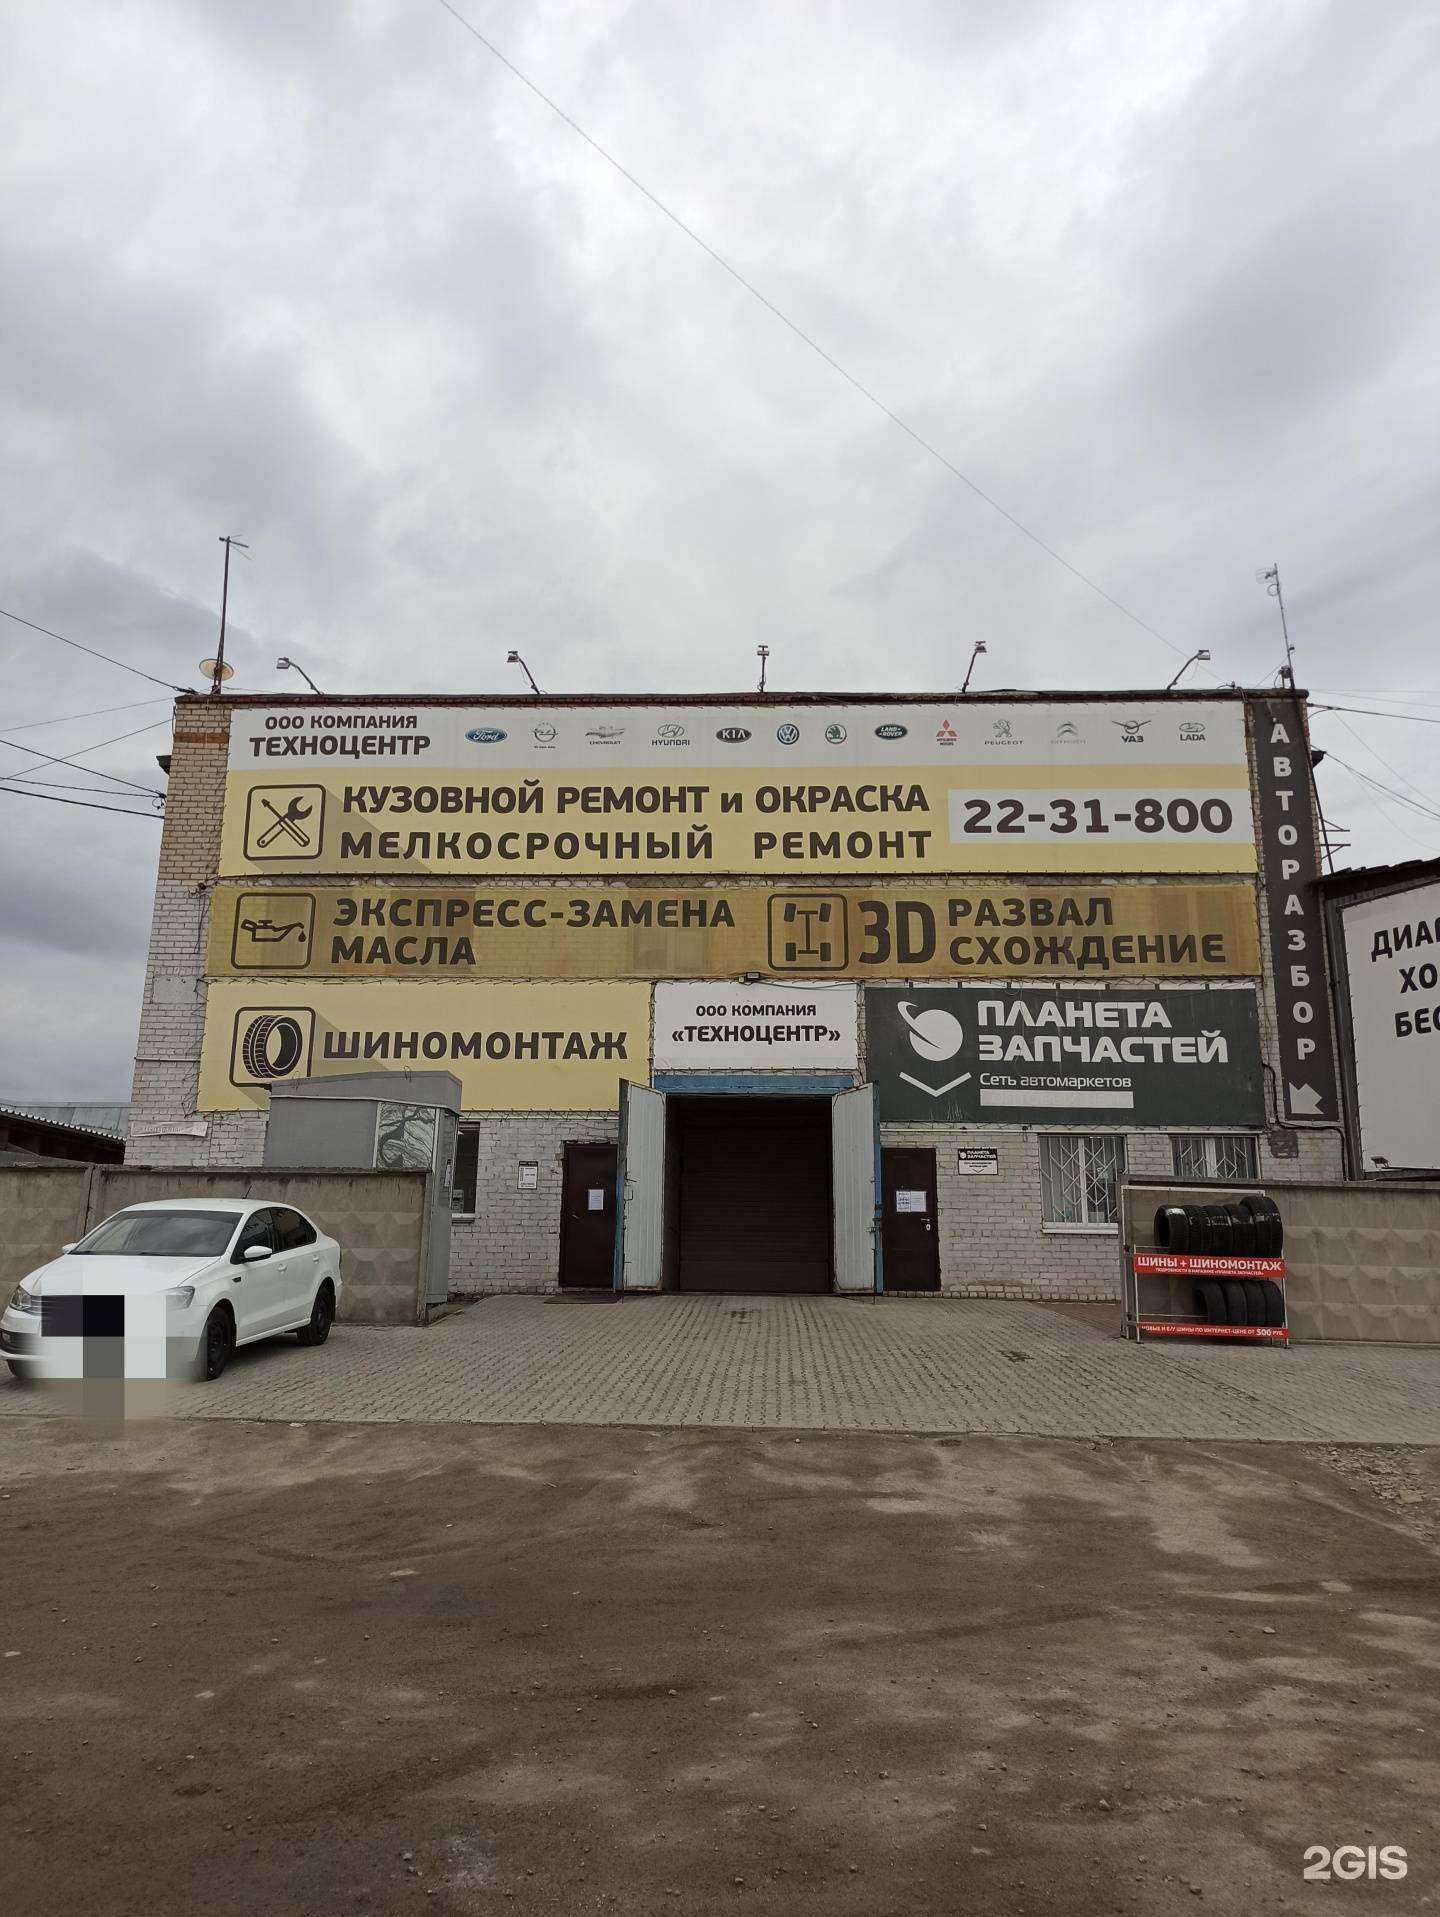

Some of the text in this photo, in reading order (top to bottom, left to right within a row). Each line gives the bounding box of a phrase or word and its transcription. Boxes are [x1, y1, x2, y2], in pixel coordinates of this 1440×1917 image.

[264, 715, 418, 730] ООО КОМПАНИЯ
[473, 728, 501, 742] Ford
[721, 730, 746, 740] KIA
[249, 735, 431, 759] ТЕХНОЦЕНТР
[1121, 735, 1144, 743] УАЗ
[1180, 734, 1206, 742] LADA
[343, 779, 930, 814] КУЗОВНОЙ РЕМОНТ и ОКРАСКА
[963, 799, 1233, 834] 22-31-800
[340, 824, 932, 860] МЕЛКОСРОЧНЫЙ РЕМОНТ
[1269, 722, 1316, 1061] АВТОРАЗБОР
[332, 898, 736, 929] ЭКСПРЕСС-ЗАМЕНА
[948, 898, 1114, 927] РАЗВАЛ
[858, 900, 937, 965] 3D
[330, 936, 476, 966] МАСЛА
[948, 934, 1226, 970] СХОЖДЕНИЕ
[696, 1004, 817, 1018] ООО КОМПАНИЯ
[978, 1001, 1172, 1028] ПЛАНЕТА
[323, 1031, 628, 1060] ШИНОМОНТАЖ
[671, 1024, 841, 1046] «ТЕХНОЦЕНТР»
[979, 1030, 1228, 1064] ЗАПЧАСТЕЙ
[980, 1072, 1132, 1090] Сеть автомаркетов
[1137, 1257, 1177, 1267] ШИНЫ
[1189, 1258, 1281, 1271] ШИНОМОНТАЖ
[1256, 1328, 1272, 1336] 500
